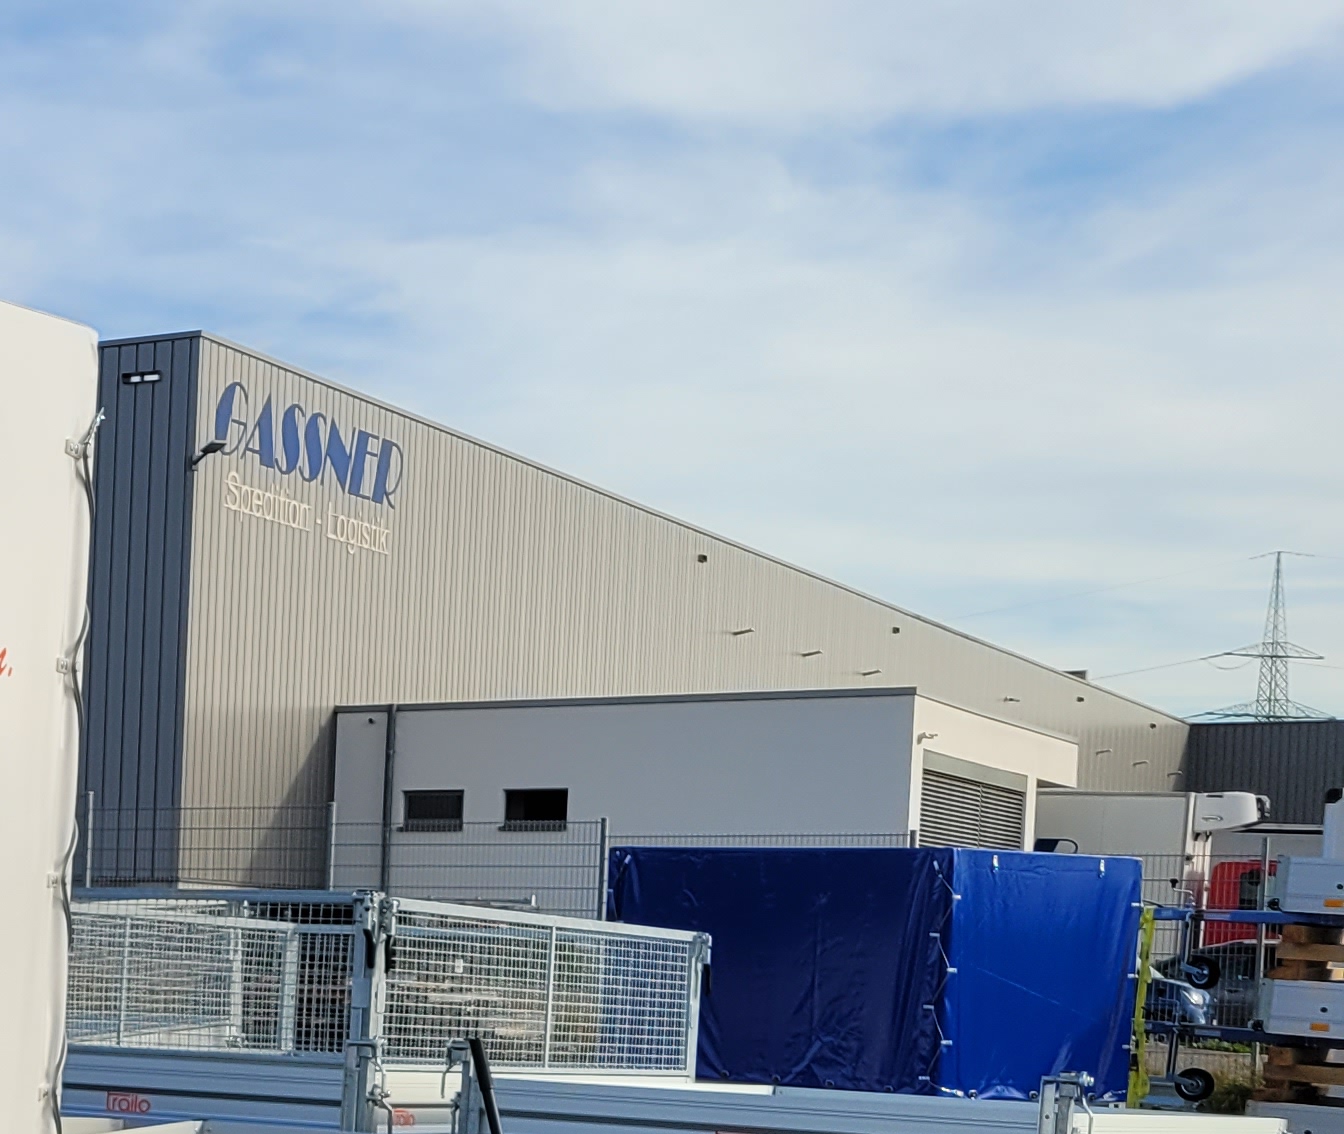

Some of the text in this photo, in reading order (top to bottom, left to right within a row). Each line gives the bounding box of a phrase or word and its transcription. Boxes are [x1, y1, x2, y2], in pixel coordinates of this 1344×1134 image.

[214, 381, 404, 510] GASSNER
[224, 471, 311, 531] Spedition
[326, 502, 390, 555] Logistik
[106, 1091, 151, 1113] trailo
